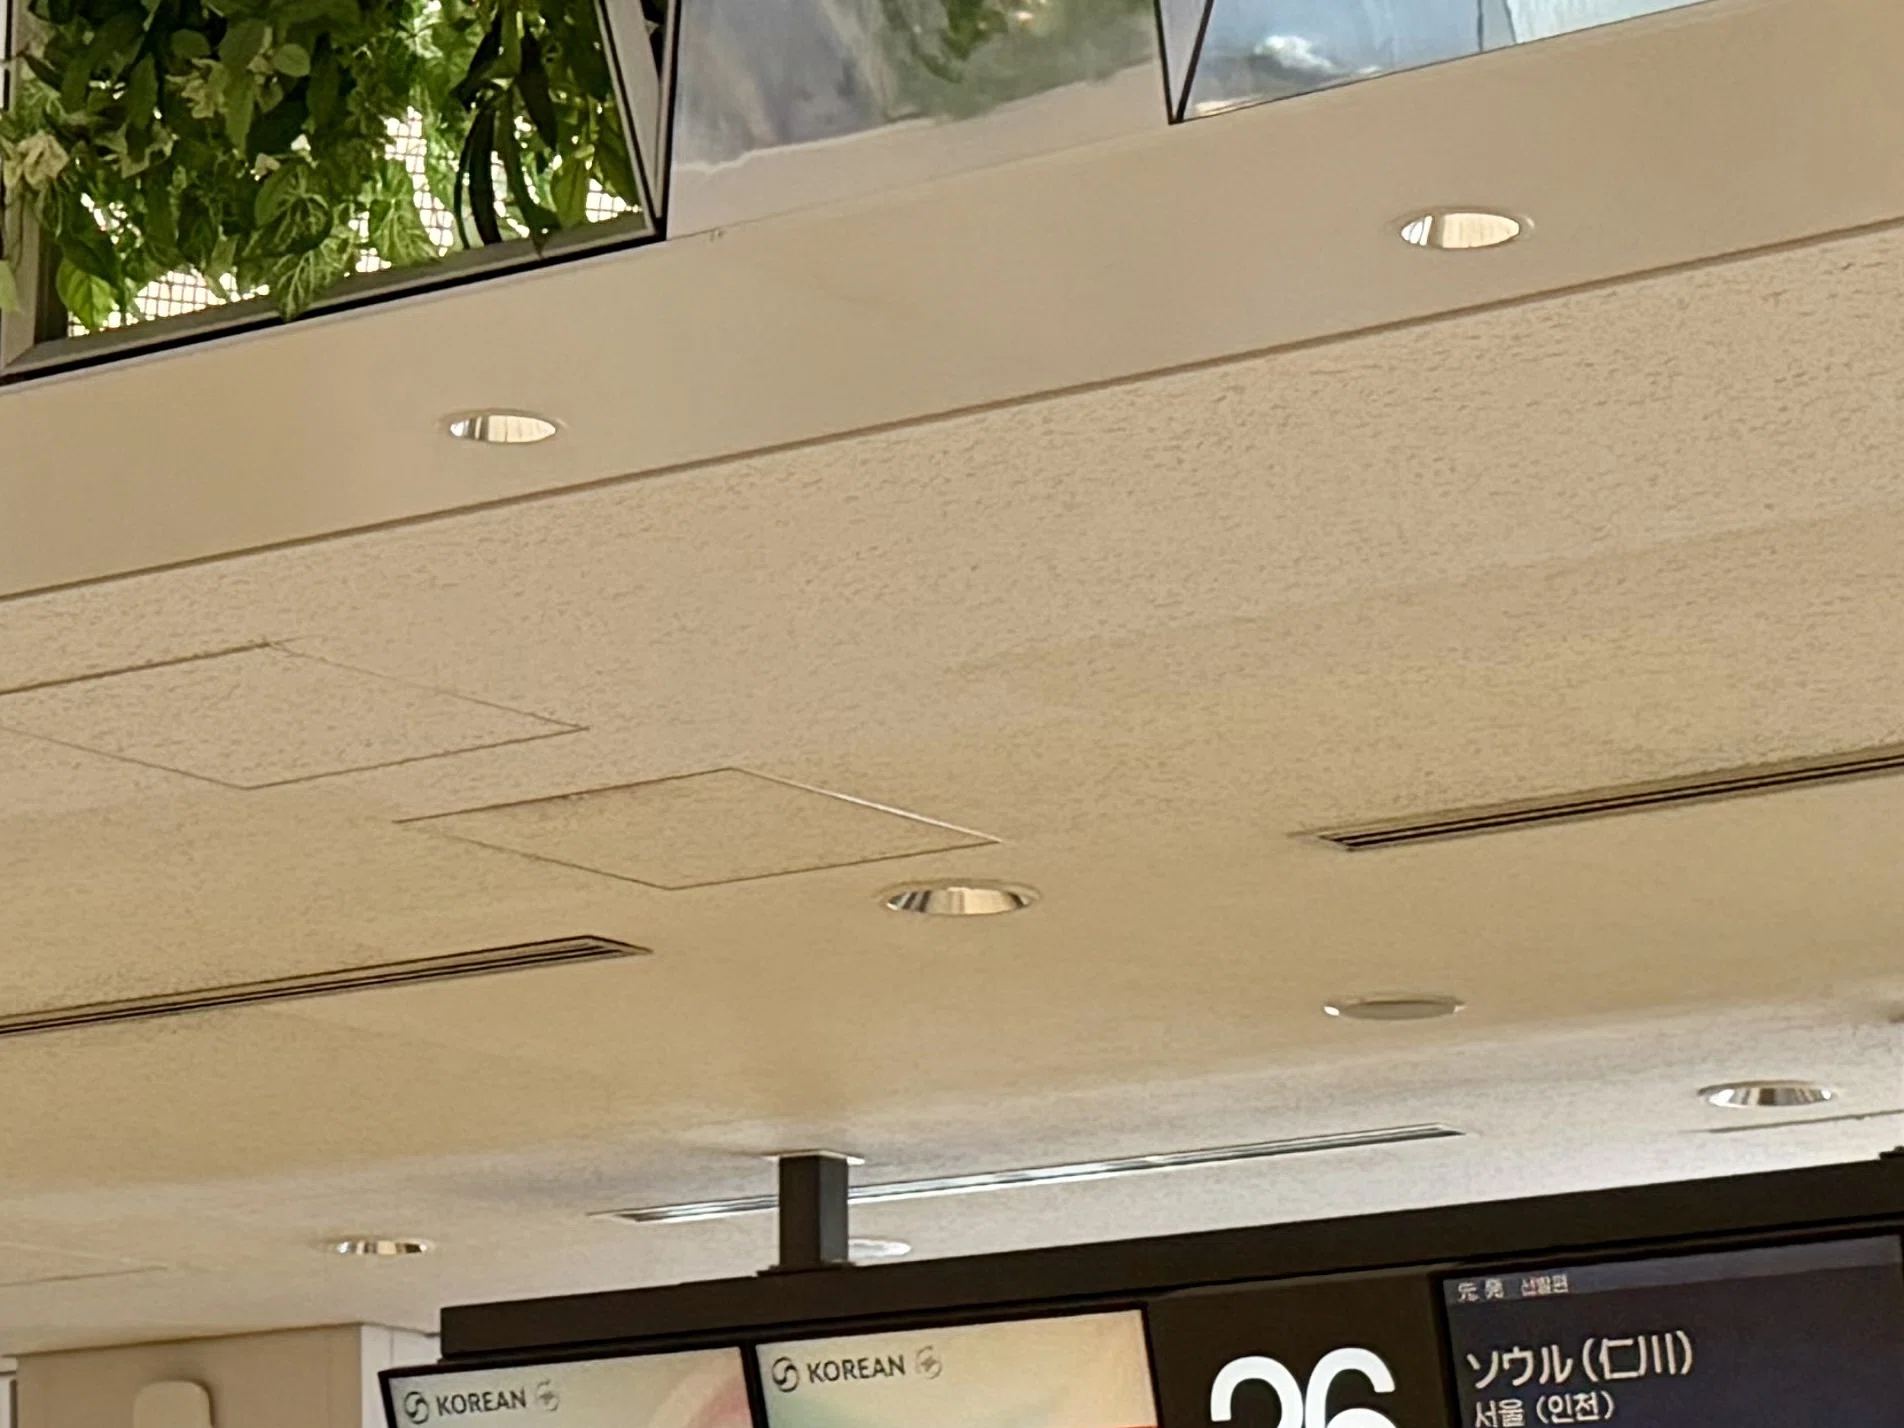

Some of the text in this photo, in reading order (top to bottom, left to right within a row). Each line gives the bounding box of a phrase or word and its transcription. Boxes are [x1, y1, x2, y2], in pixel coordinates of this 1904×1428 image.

[807, 1355, 906, 1383] KOREAN
[436, 1387, 527, 1417] KOREAN
[1474, 1390, 1616, 1428] 서울 (인천)
